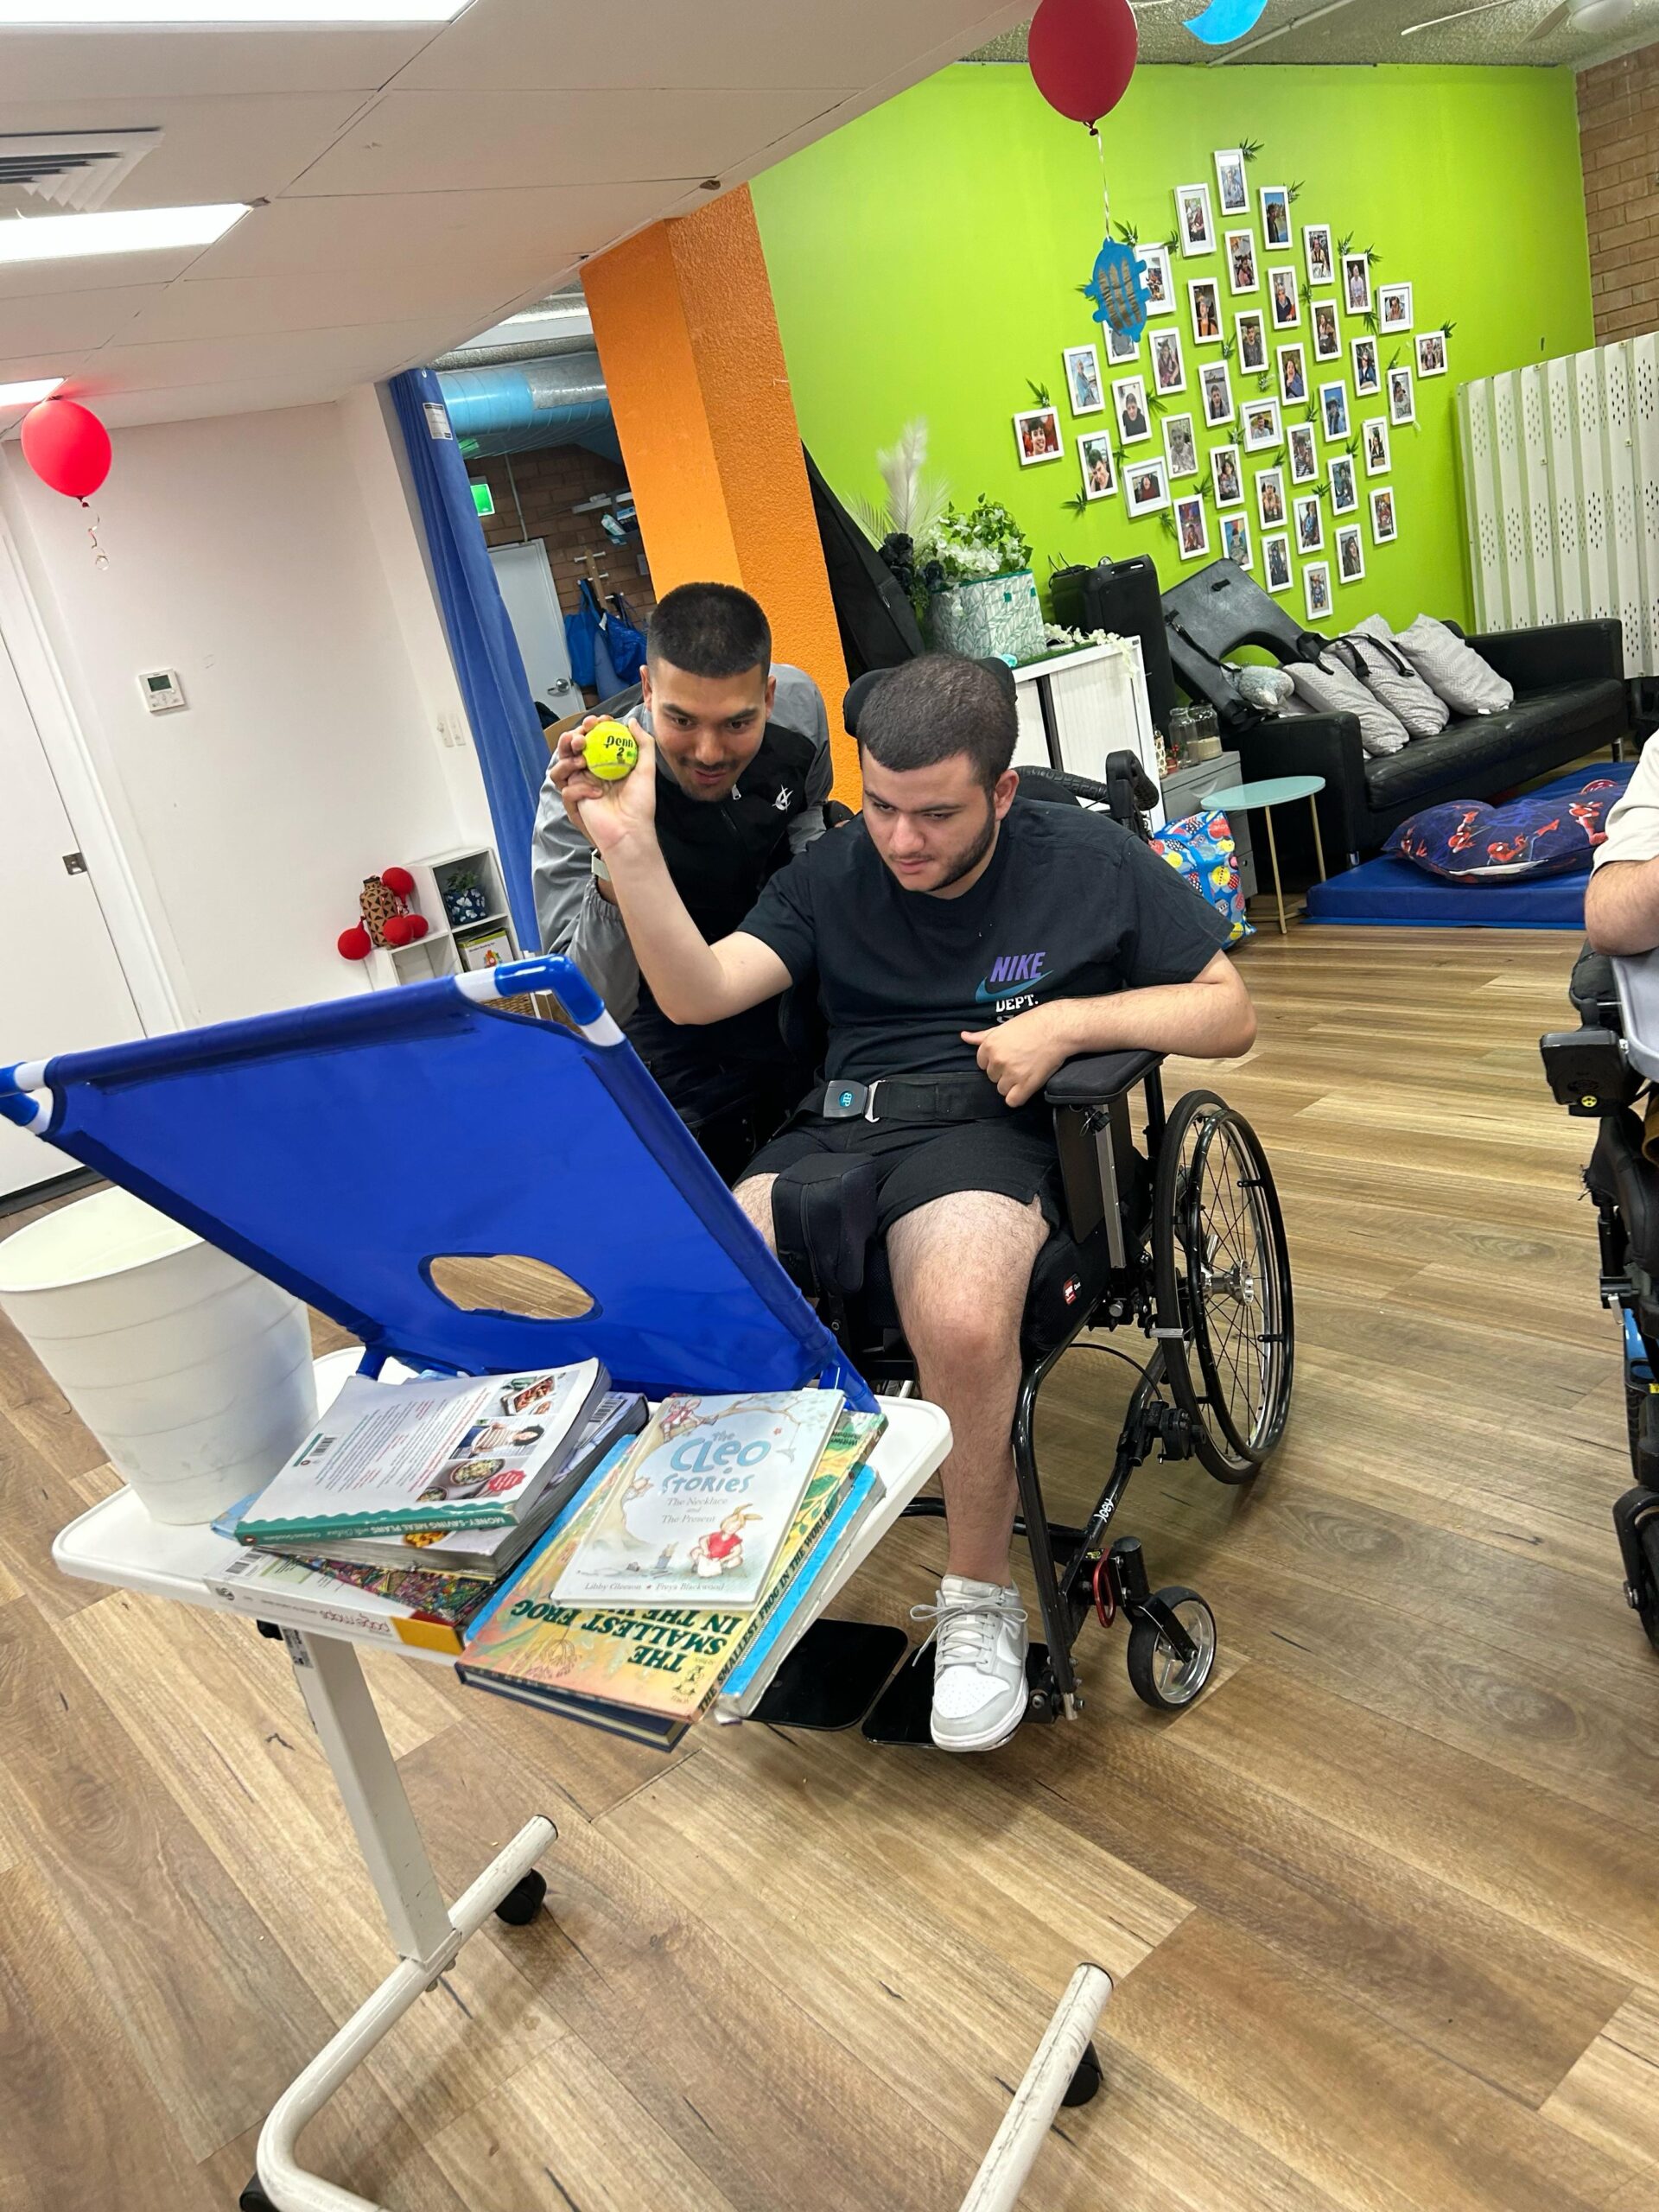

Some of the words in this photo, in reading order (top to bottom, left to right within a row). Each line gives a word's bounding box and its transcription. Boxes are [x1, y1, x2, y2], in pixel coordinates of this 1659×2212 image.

[616, 747, 625, 757] 2
[989, 951, 1046, 982] NIKE
[995, 994, 1039, 1013] DEPT.
[712, 1430, 735, 1442] The
[667, 1497, 686, 1506] The
[687, 1497, 728, 1505] Necklace
[1093, 1498, 1115, 1523] Joey
[370, 1524, 403, 1534] PLANS
[401, 1523, 428, 1532] MEAL
[428, 1516, 505, 1529] MONEY-SAVING
[662, 1515, 681, 1524] The
[682, 1515, 715, 1523] Present
[584, 1582, 607, 1592] Libby
[680, 1582, 725, 1592] Blackwood
[511, 1599, 582, 1627] FROG
[642, 1609, 701, 1628] THE
[698, 1683, 718, 1714] THE
[717, 1619, 759, 1686] SMALLEST
[759, 1588, 781, 1623] FROG
[779, 1573, 791, 1590] IN
[790, 1549, 806, 1573] THE
[804, 1509, 831, 1549] WORLD
[701, 1612, 743, 1636] IN
[582, 1612, 728, 1656] SMALLEST
[627, 1644, 688, 1673] THE
